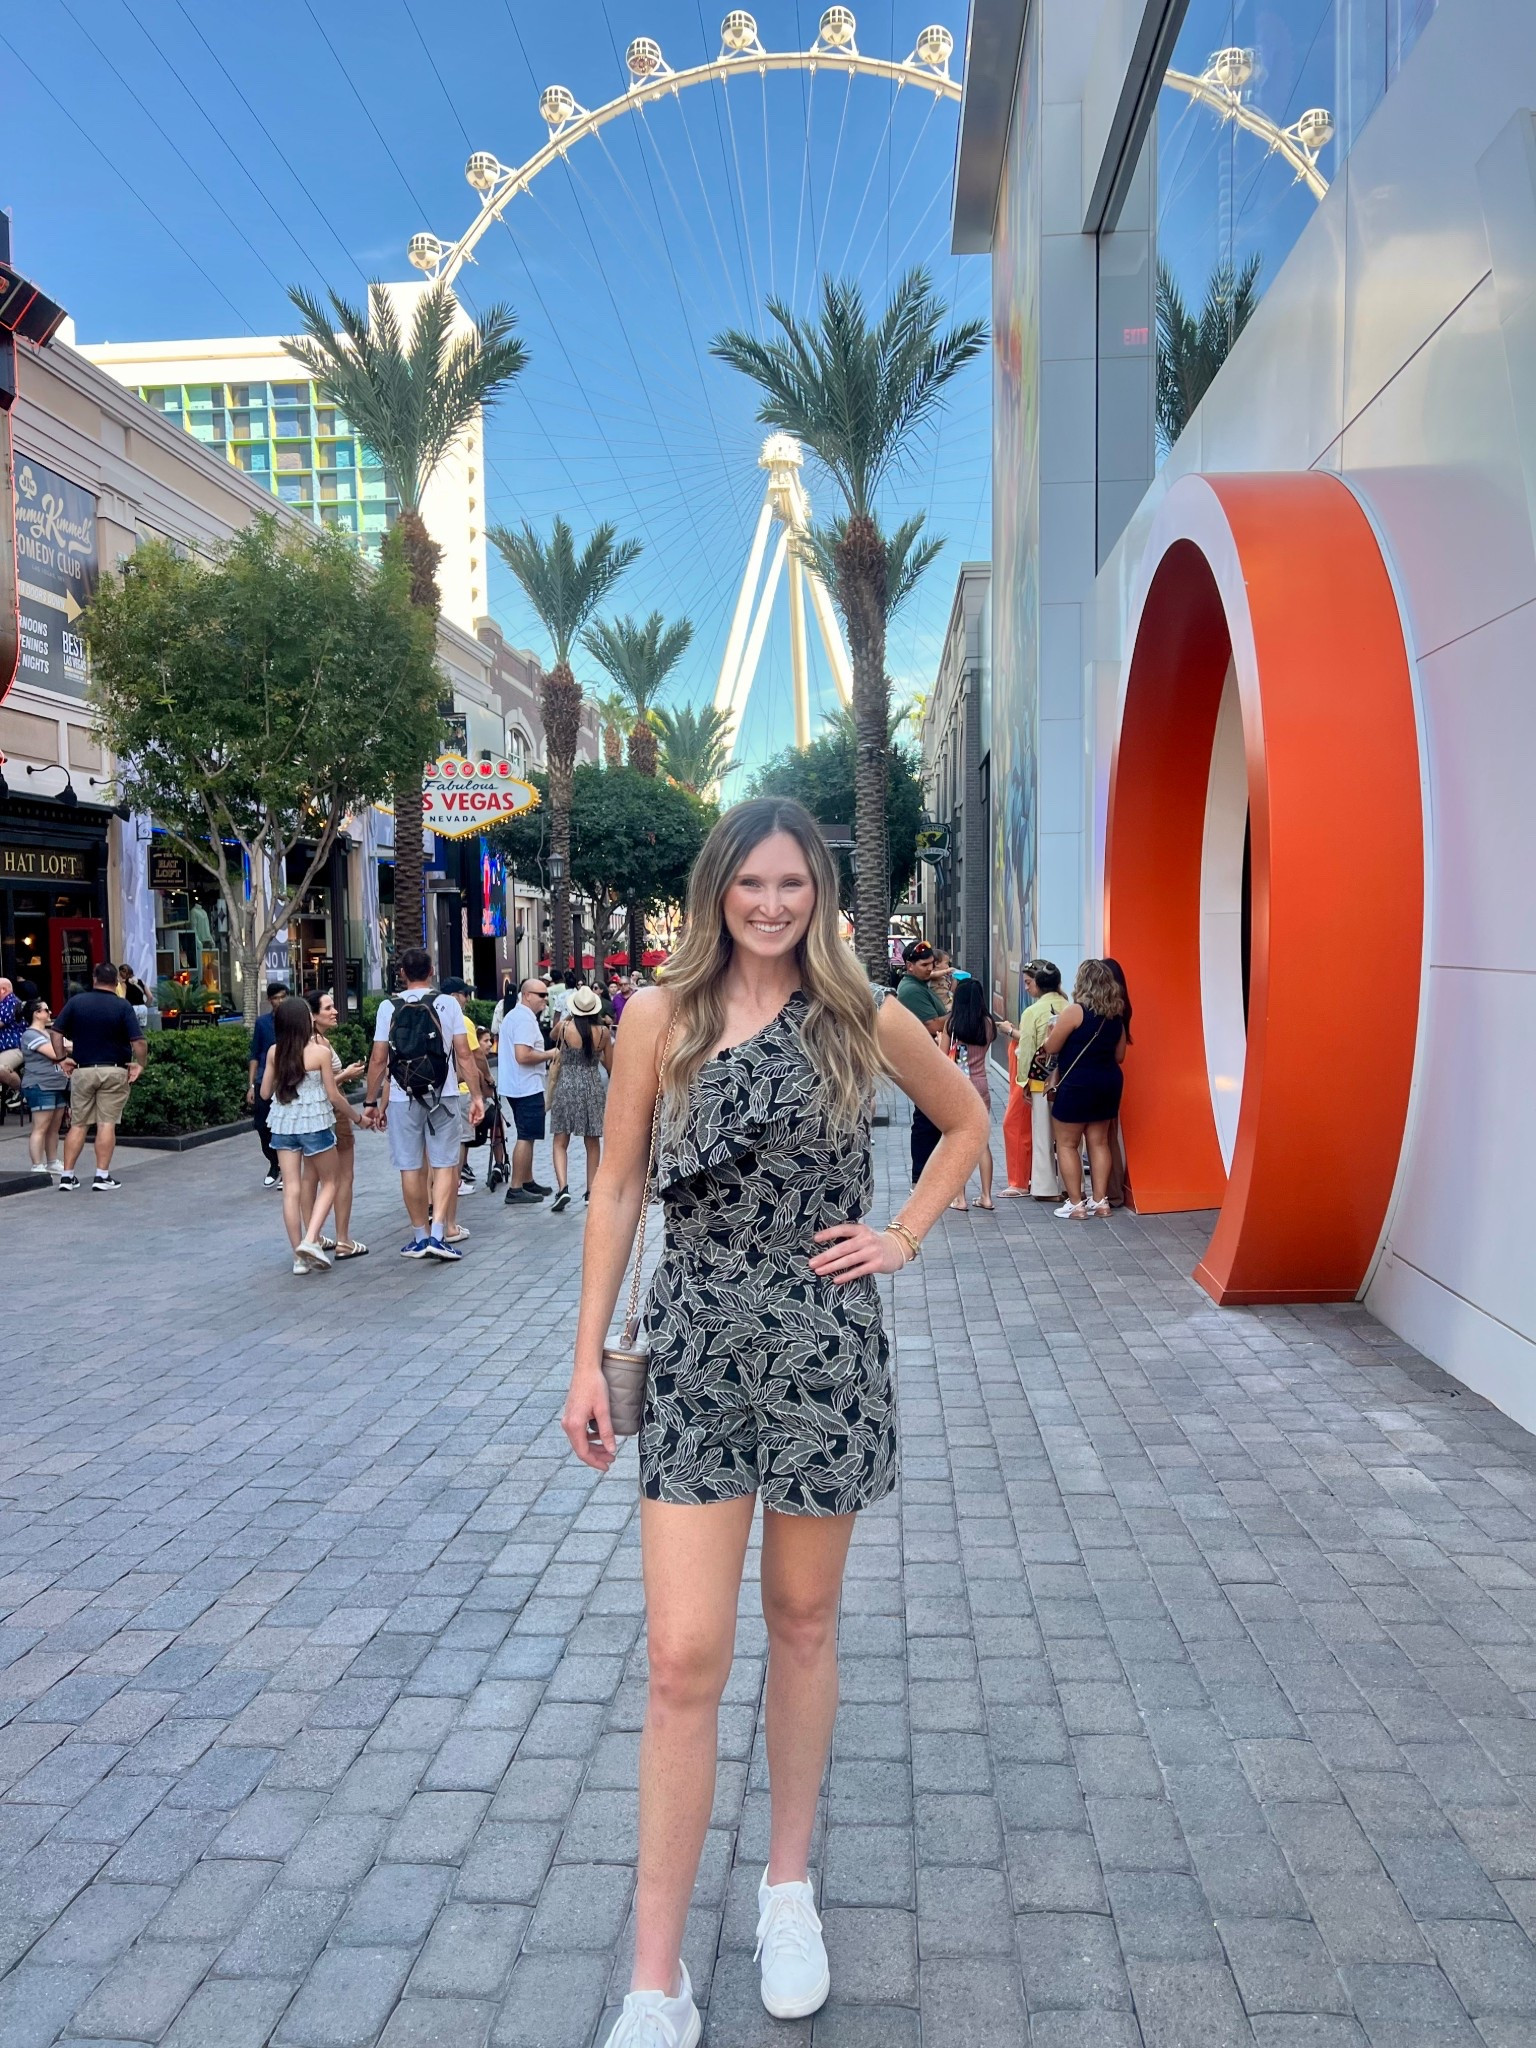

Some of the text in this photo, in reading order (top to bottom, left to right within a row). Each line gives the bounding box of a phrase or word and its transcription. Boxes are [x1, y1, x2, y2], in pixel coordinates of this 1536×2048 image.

[1123, 328, 1149, 345] EXIT
[17, 533, 55, 569] OMEDY
[57, 551, 81, 580] CLUB
[62, 630, 85, 659] BEST
[21, 653, 50, 674] NIGHTS
[422, 780, 499, 791] Fabulous
[440, 792, 515, 811] VEGAS
[4, 851, 77, 875] HAT LOFT
[72, 955, 88, 964] SHOP
